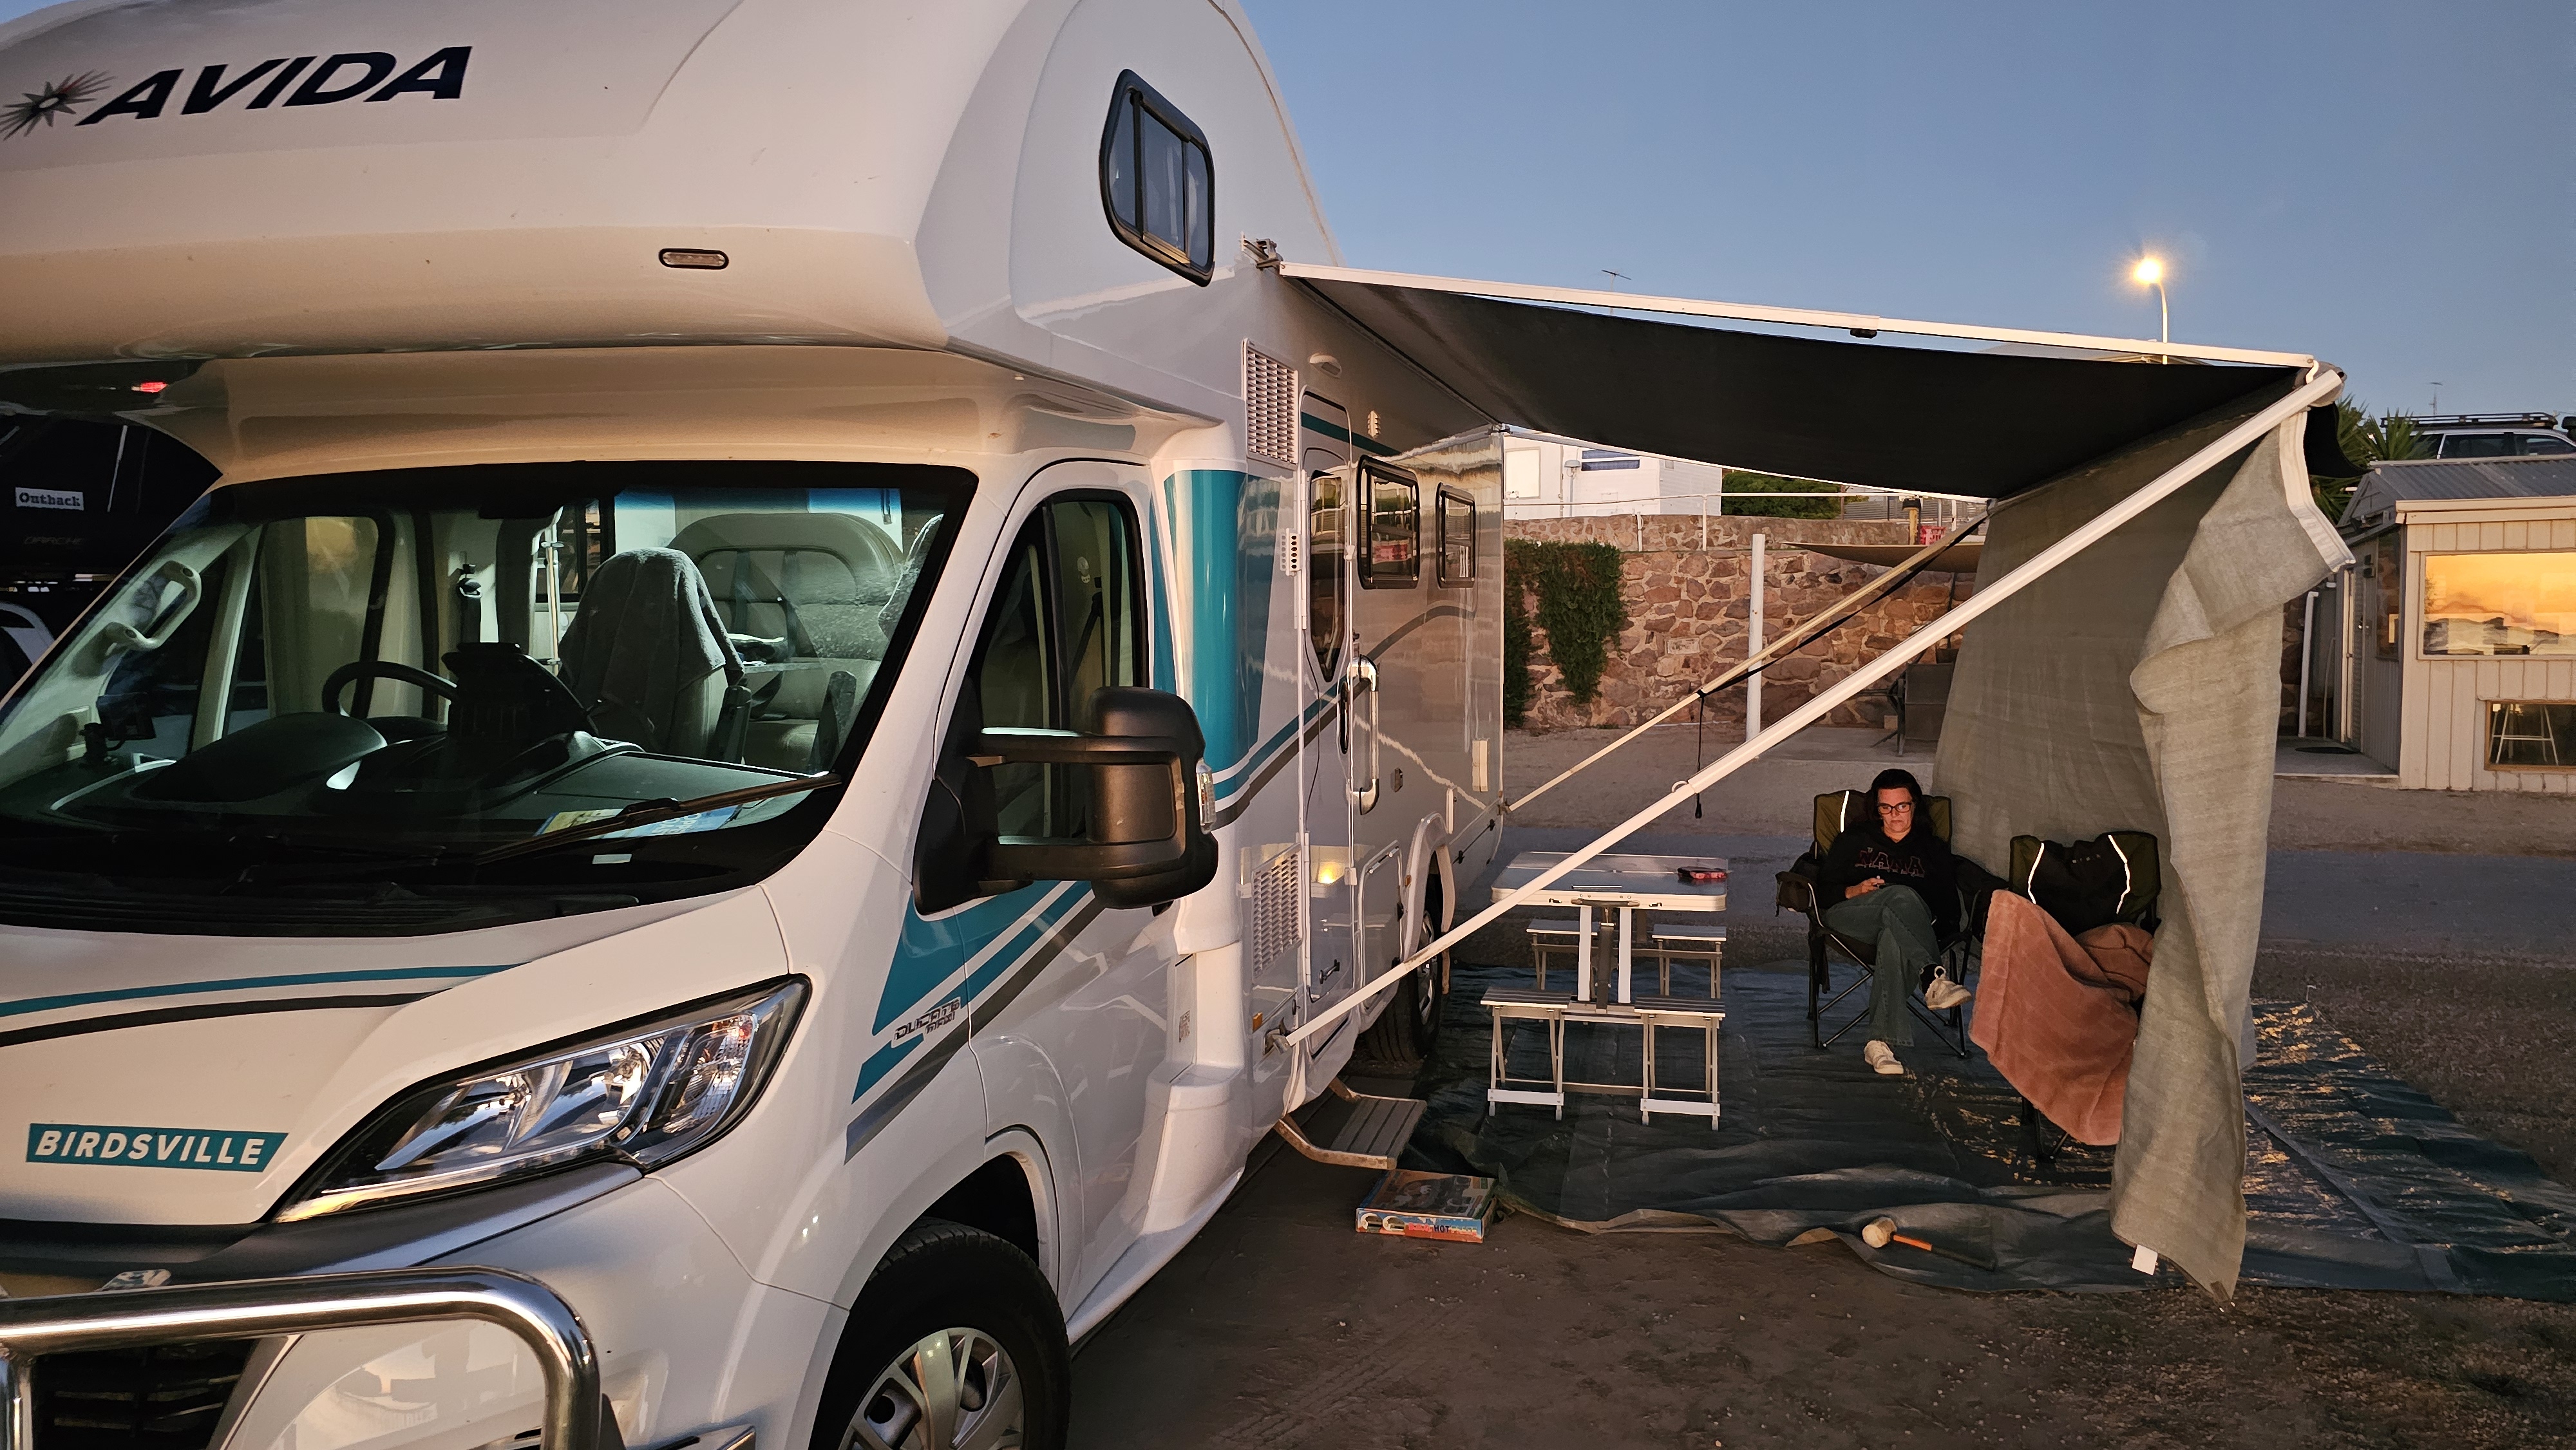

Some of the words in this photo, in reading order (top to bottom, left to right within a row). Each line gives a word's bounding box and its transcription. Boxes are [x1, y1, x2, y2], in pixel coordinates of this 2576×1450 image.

[75, 46, 473, 126] AVIDA
[19, 492, 80, 507] Outback
[894, 999, 960, 1040] DUCATO
[925, 1011, 956, 1034] MAXI
[35, 1129, 267, 1165] BIRDSVILLE
[1434, 1225, 1450, 1233] HOT
